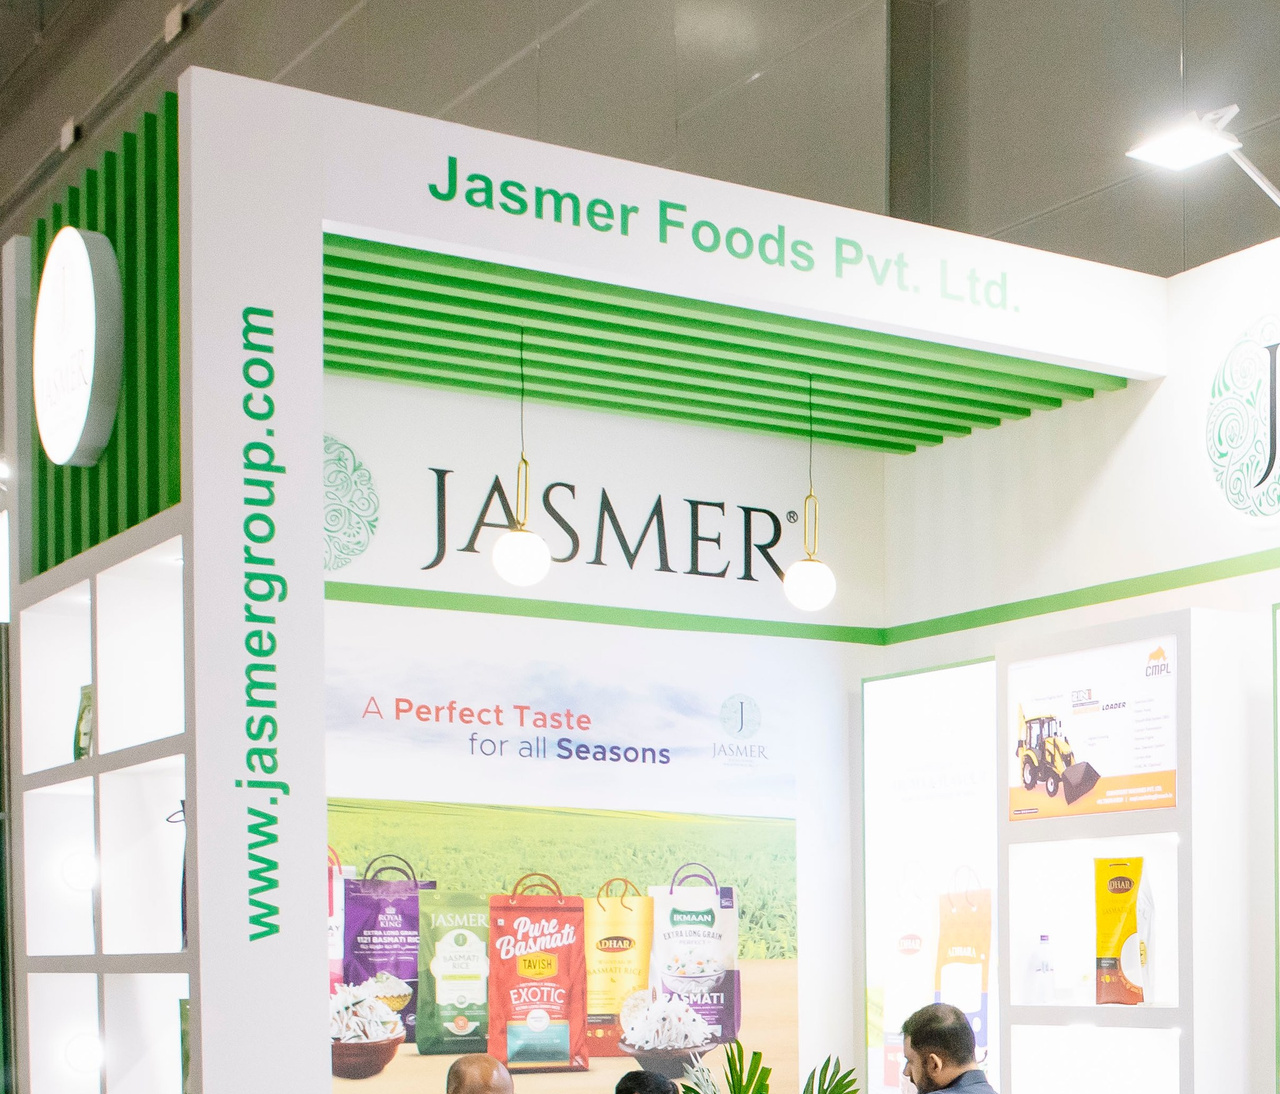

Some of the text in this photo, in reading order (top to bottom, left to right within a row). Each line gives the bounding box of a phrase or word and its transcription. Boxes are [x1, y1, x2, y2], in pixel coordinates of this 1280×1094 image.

[428, 156, 1020, 312] Jasmer Foods Pvt. Ltd.
[234, 304, 290, 943] www.jasmergroup.com
[1145, 663, 1172, 677] CMPL
[362, 696, 592, 731] A Perfect Taste
[1101, 702, 1127, 711] LOADER
[469, 732, 671, 765] for all Seasons
[712, 742, 769, 760] JASMER
[380, 920, 402, 928] KING
[430, 913, 490, 928] JASMER
[673, 914, 712, 922] IKMAAN
[513, 916, 559, 941] Pure
[663, 930, 722, 940] EXTRA LONG GRAIN
[496, 926, 576, 960] Basmati
[522, 958, 553, 970] TAVISH
[509, 987, 567, 1004] EXOTIC
